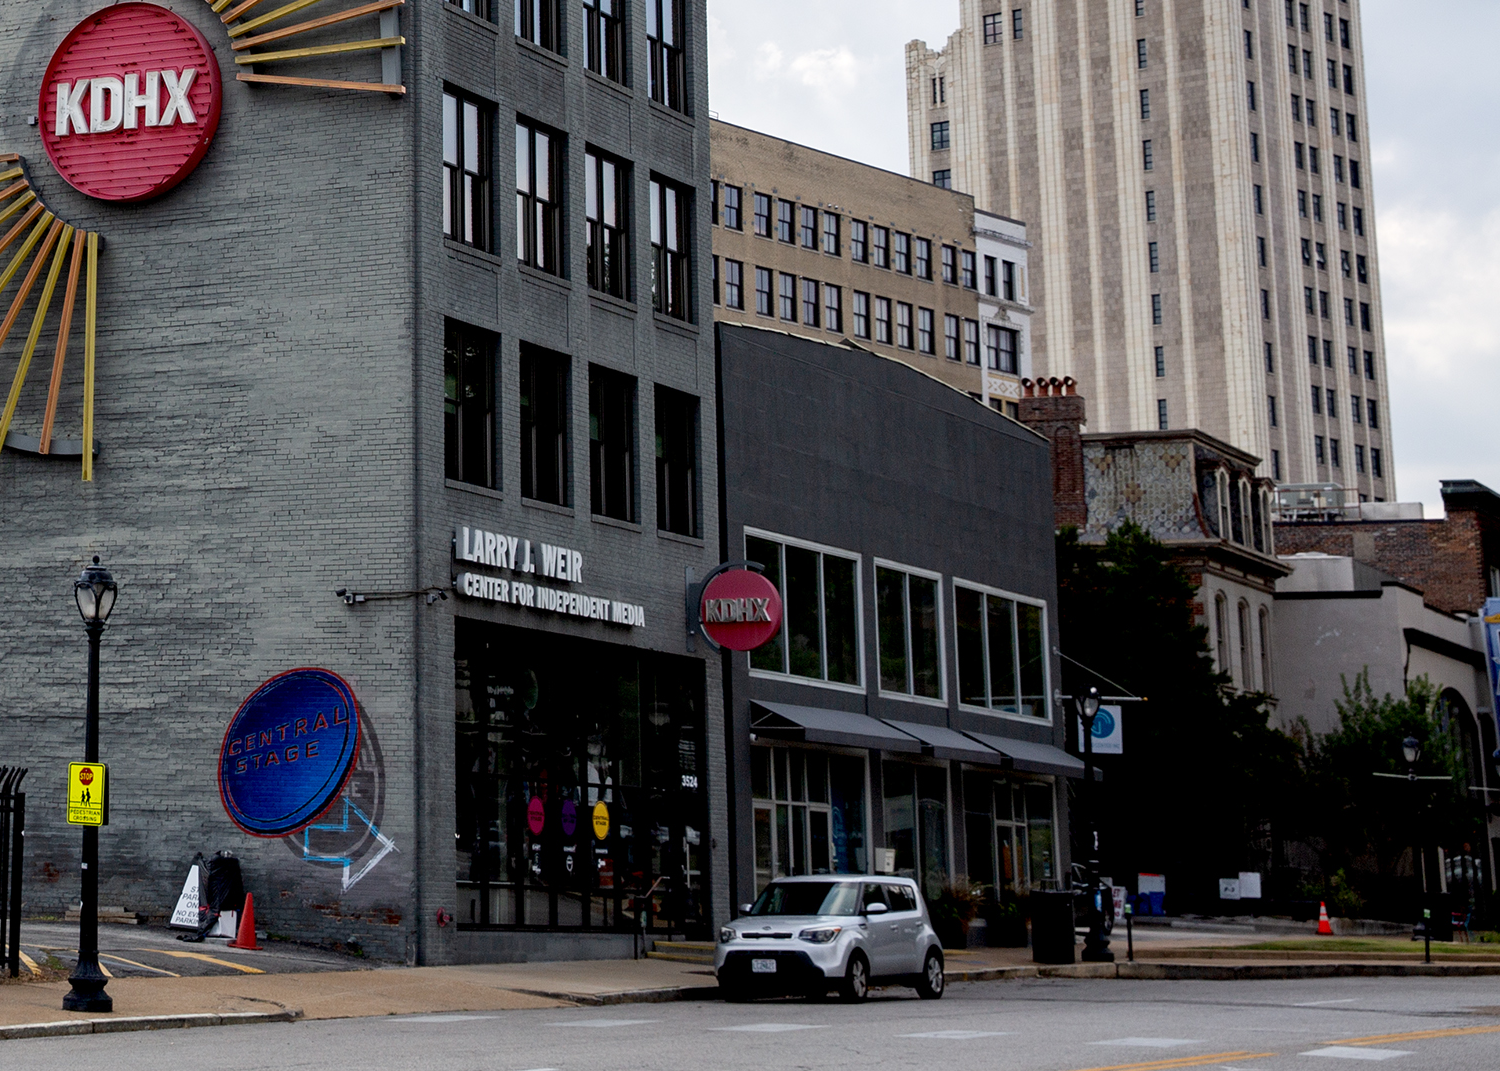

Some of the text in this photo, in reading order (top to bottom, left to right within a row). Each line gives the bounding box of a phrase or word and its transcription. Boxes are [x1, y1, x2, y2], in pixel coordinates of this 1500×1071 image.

[55, 68, 198, 137] KDHX
[462, 526, 583, 584] LARRY J. WEIR
[463, 572, 646, 628] CENTER FOR INDEPENDENT MEDIA
[705, 597, 772, 622] KDHX
[228, 705, 349, 756] CENTRAL
[235, 739, 320, 775] STAGE
[80, 772, 93, 781] STOP
[681, 774, 698, 788] 3524
[186, 901, 199, 909] ON
[187, 910, 199, 918] EV
